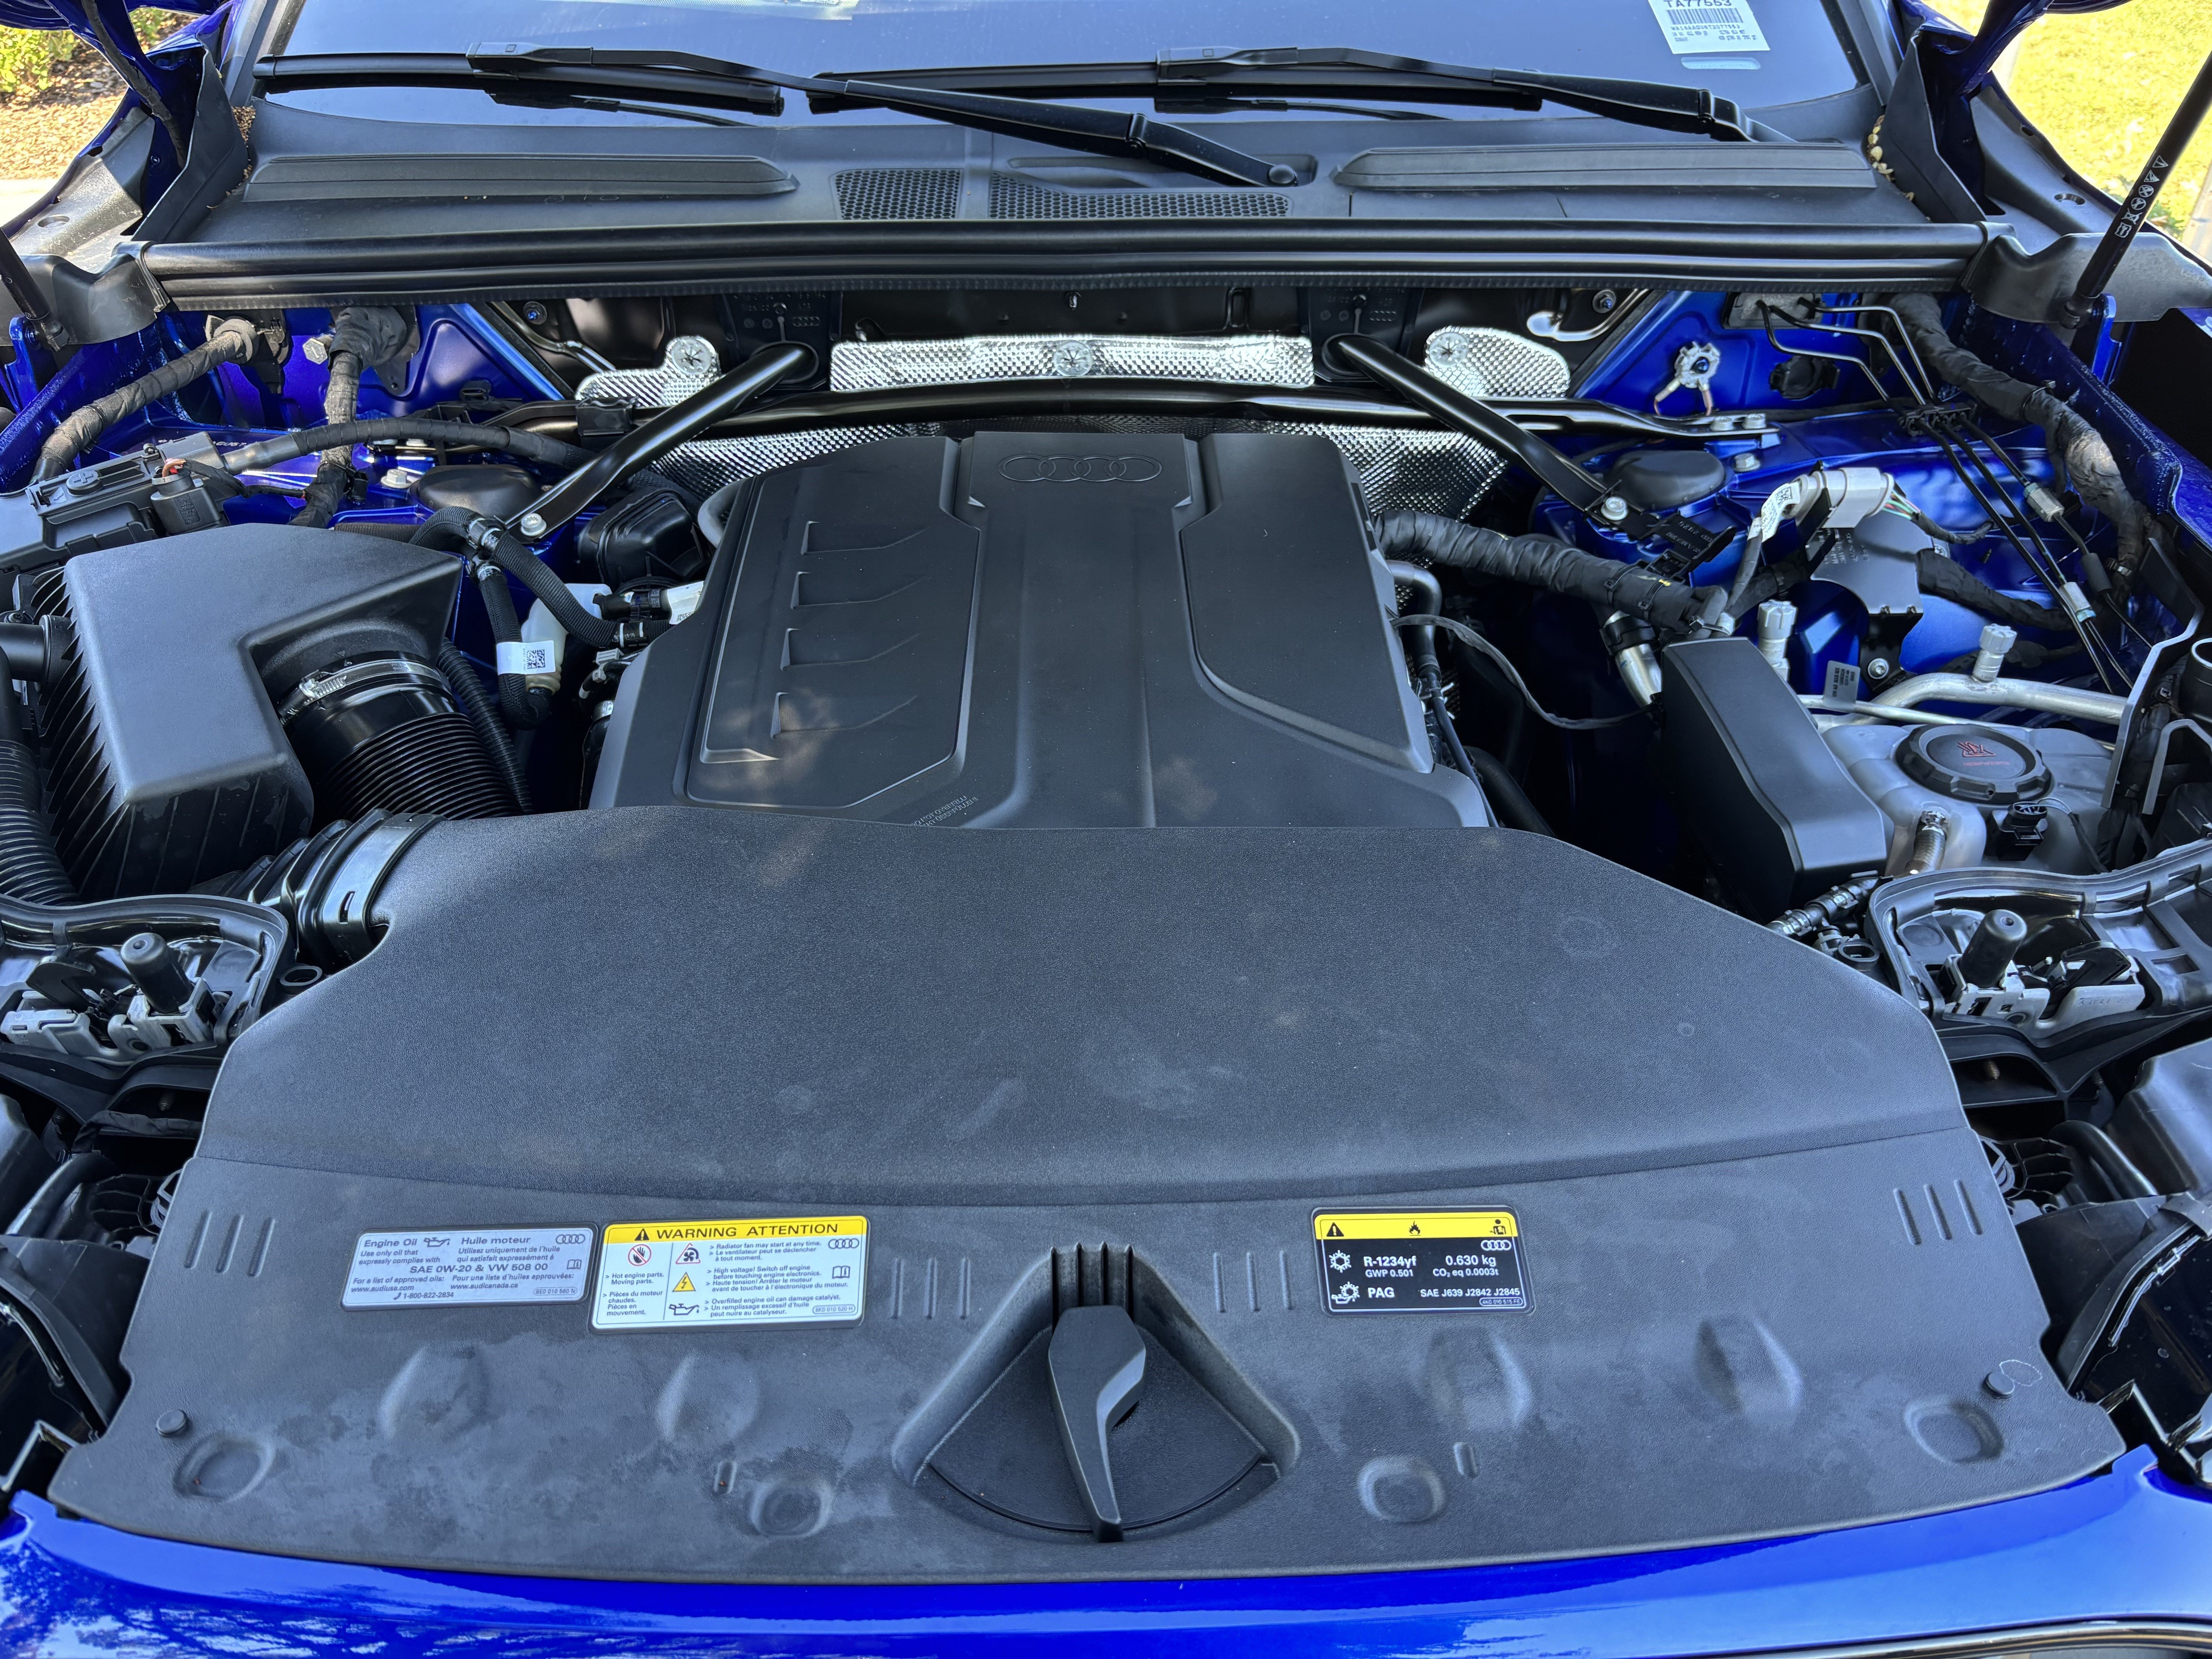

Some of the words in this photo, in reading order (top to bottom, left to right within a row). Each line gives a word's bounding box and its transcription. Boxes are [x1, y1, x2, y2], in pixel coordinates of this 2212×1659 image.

[657, 1227, 737, 1239] WARNING
[746, 1223, 838, 1236] ATTENTION
[364, 1239, 400, 1248] Engine
[499, 1254, 548, 1262] expressément
[1363, 1255, 1417, 1268] R-1234yf
[1445, 1255, 1479, 1266] 0.630
[1481, 1254, 1496, 1267] kg
[410, 1266, 433, 1274] SAE
[436, 1264, 472, 1273] 0W-20
[488, 1264, 509, 1272] VW
[1365, 1269, 1388, 1278] GWP
[1389, 1269, 1413, 1278] 0.501
[1465, 1267, 1499, 1276] 0.0003t
[393, 1276, 428, 1284] approved
[531, 1273, 574, 1281] approuvées:
[1367, 1287, 1395, 1298] PAG
[1420, 1288, 1440, 1298] SAE
[1441, 1288, 1463, 1297] J639
[1465, 1288, 1492, 1297] J2842
[1494, 1288, 1520, 1296] J2845
